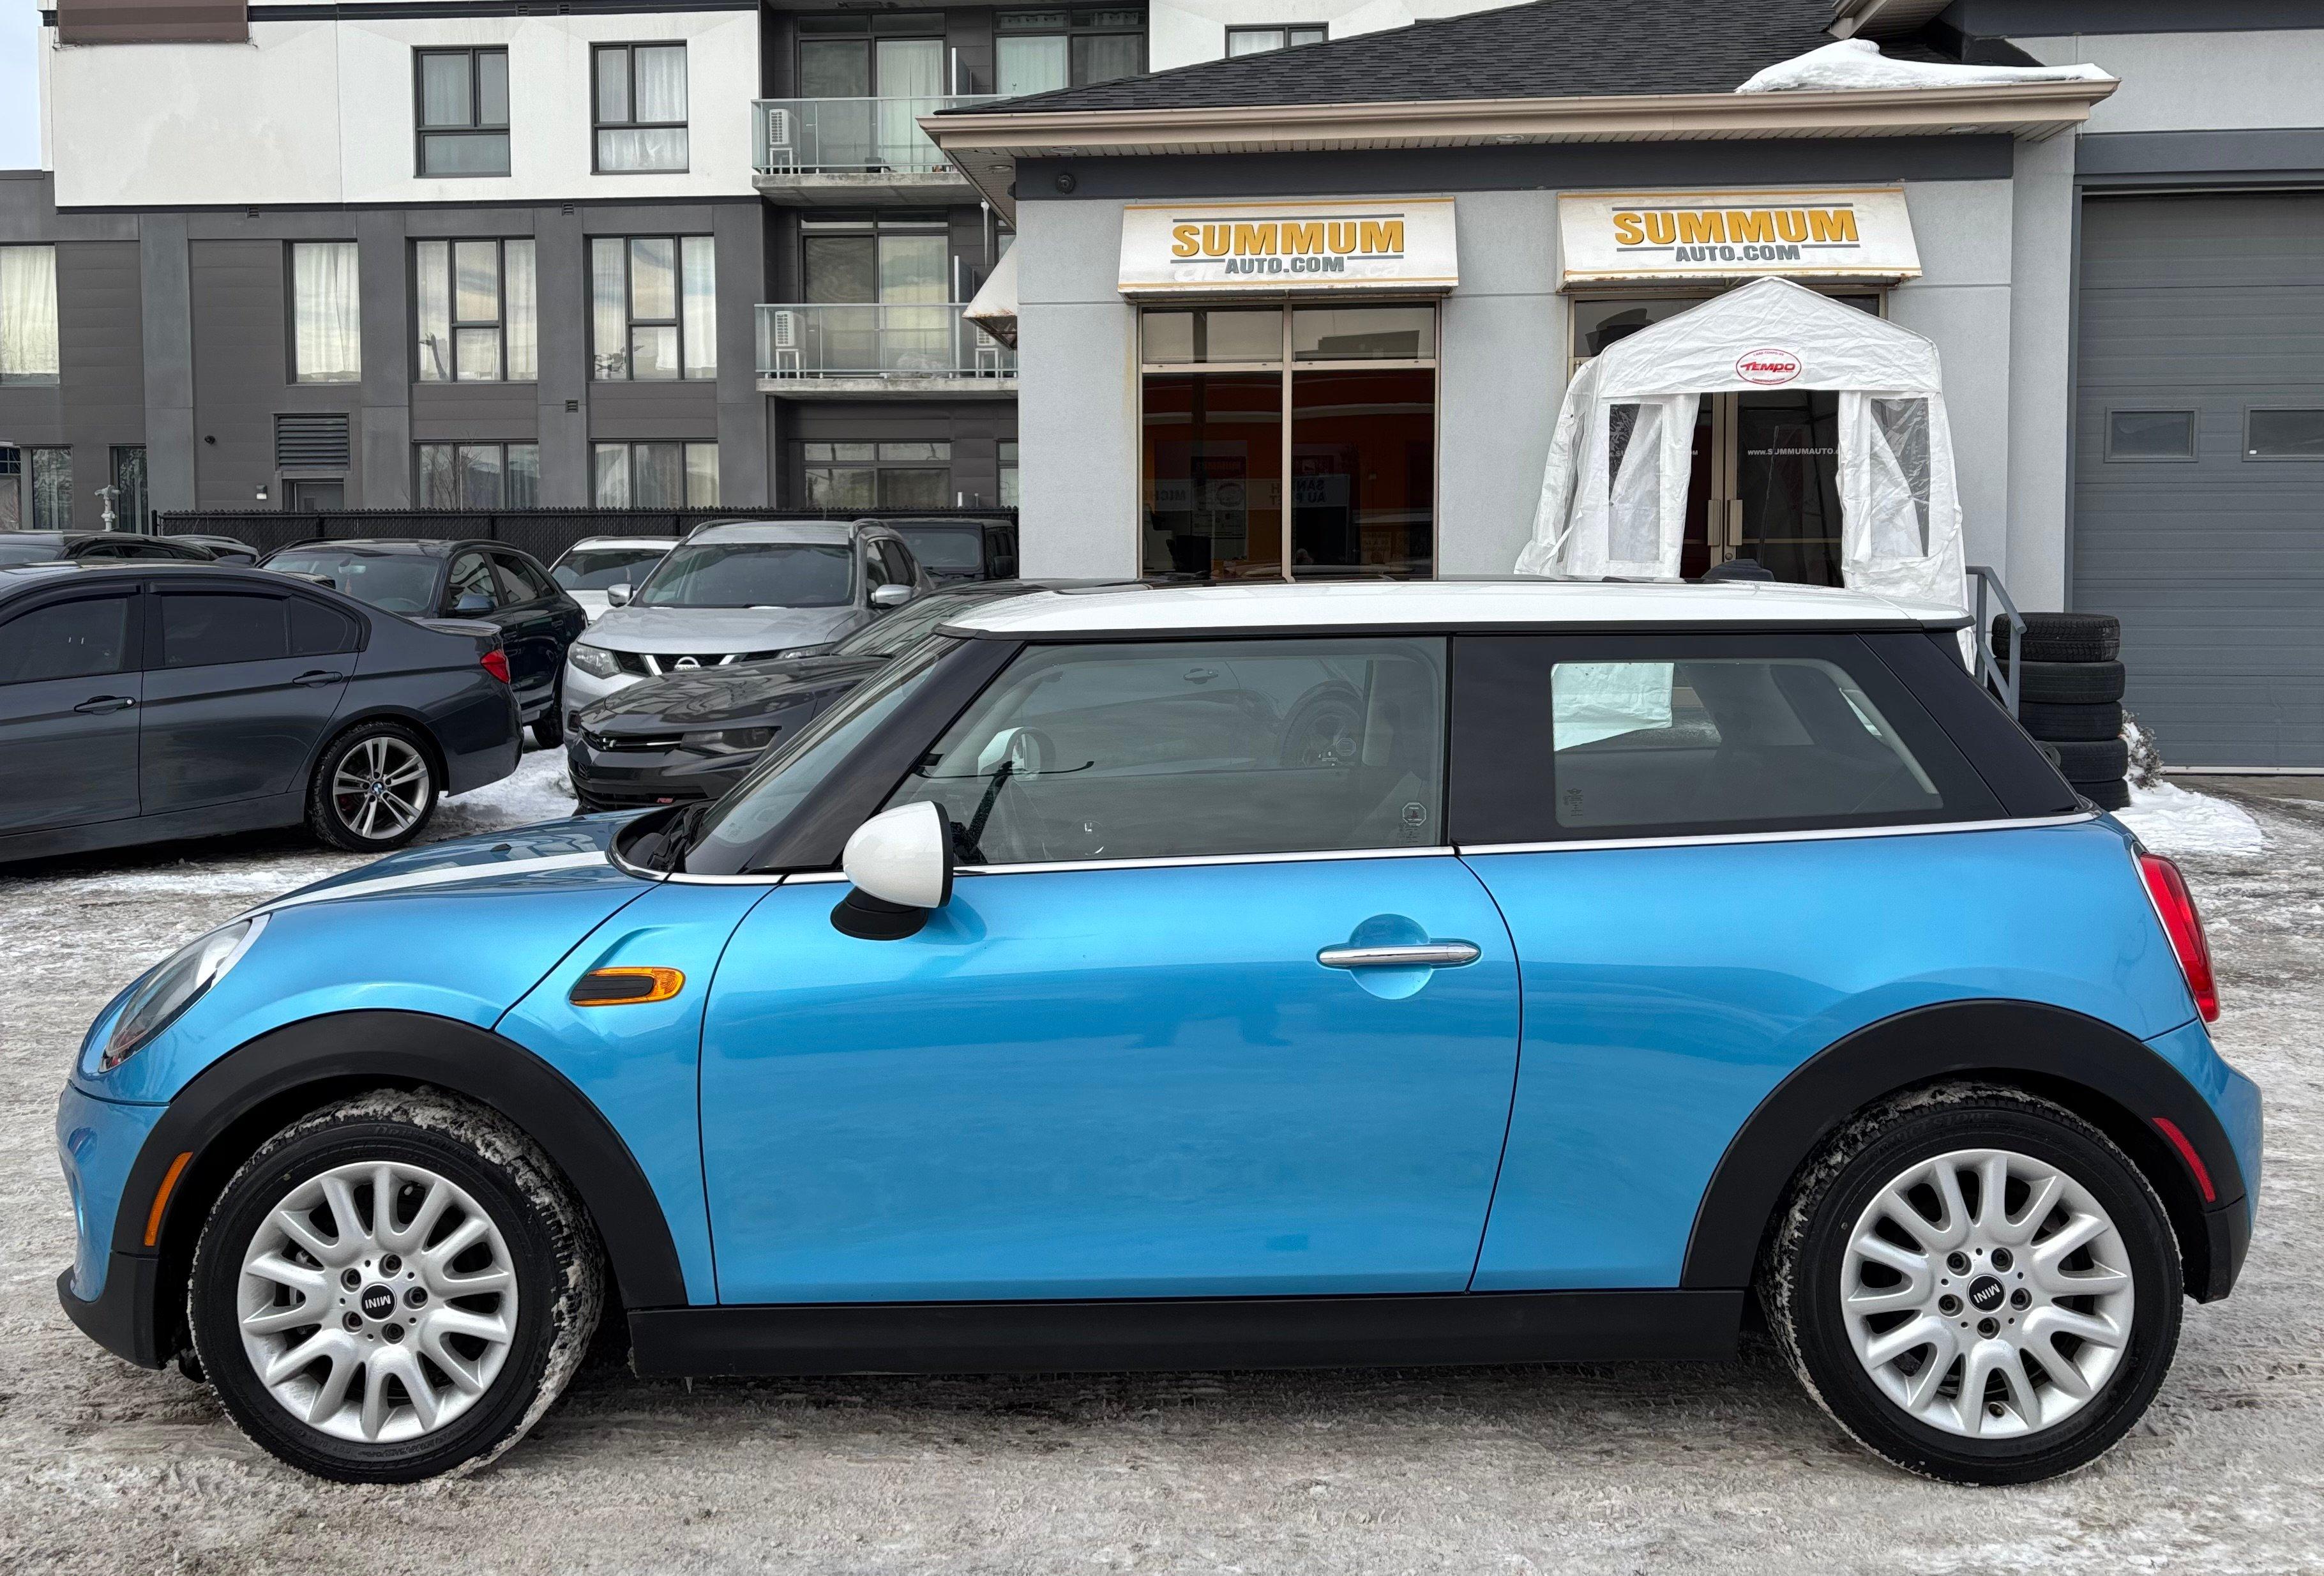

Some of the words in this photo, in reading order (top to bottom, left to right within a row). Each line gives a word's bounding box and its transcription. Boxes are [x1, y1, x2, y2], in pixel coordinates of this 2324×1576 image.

[1613, 209, 1859, 244] SUMMUM
[1172, 220, 1404, 257] SUMMUM
[1676, 245, 1800, 262] AUTO.COM
[1225, 256, 1345, 274] AUTO.COM
[1740, 361, 1795, 373] TEMPO
[365, 1294, 391, 1309] MINI
[1973, 1284, 2000, 1303] MINI
